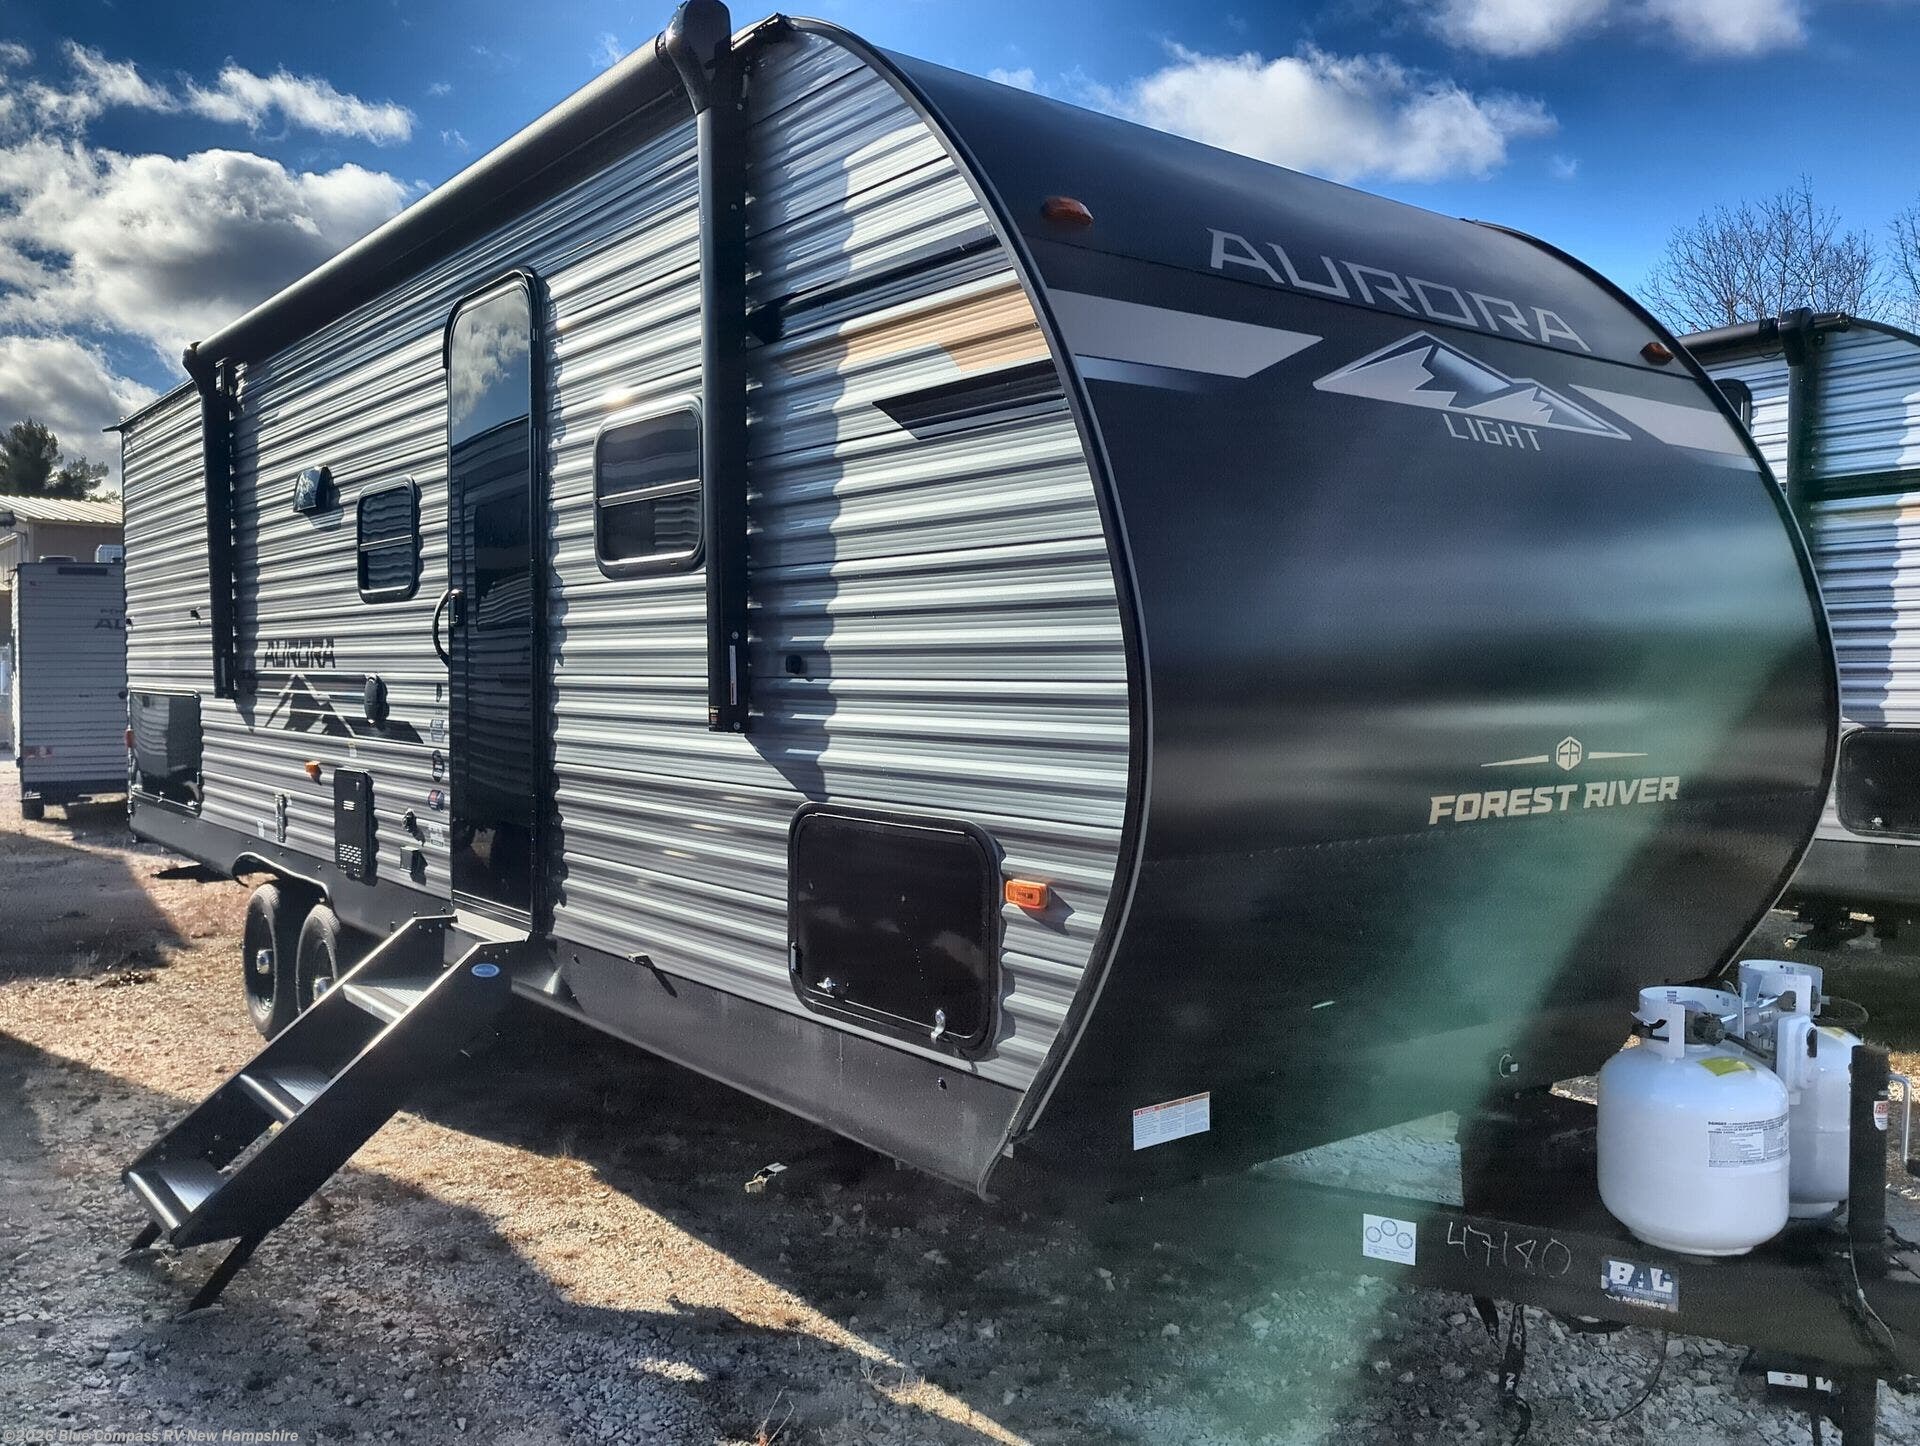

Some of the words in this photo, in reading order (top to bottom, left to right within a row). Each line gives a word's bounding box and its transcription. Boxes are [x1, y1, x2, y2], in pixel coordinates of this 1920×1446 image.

[1206, 227, 1592, 352] AURORA
[1442, 413, 1541, 451] LIGHT
[264, 638, 336, 669] AURORA
[1428, 784, 1579, 825] FOREST
[1583, 776, 1680, 809] RIVER
